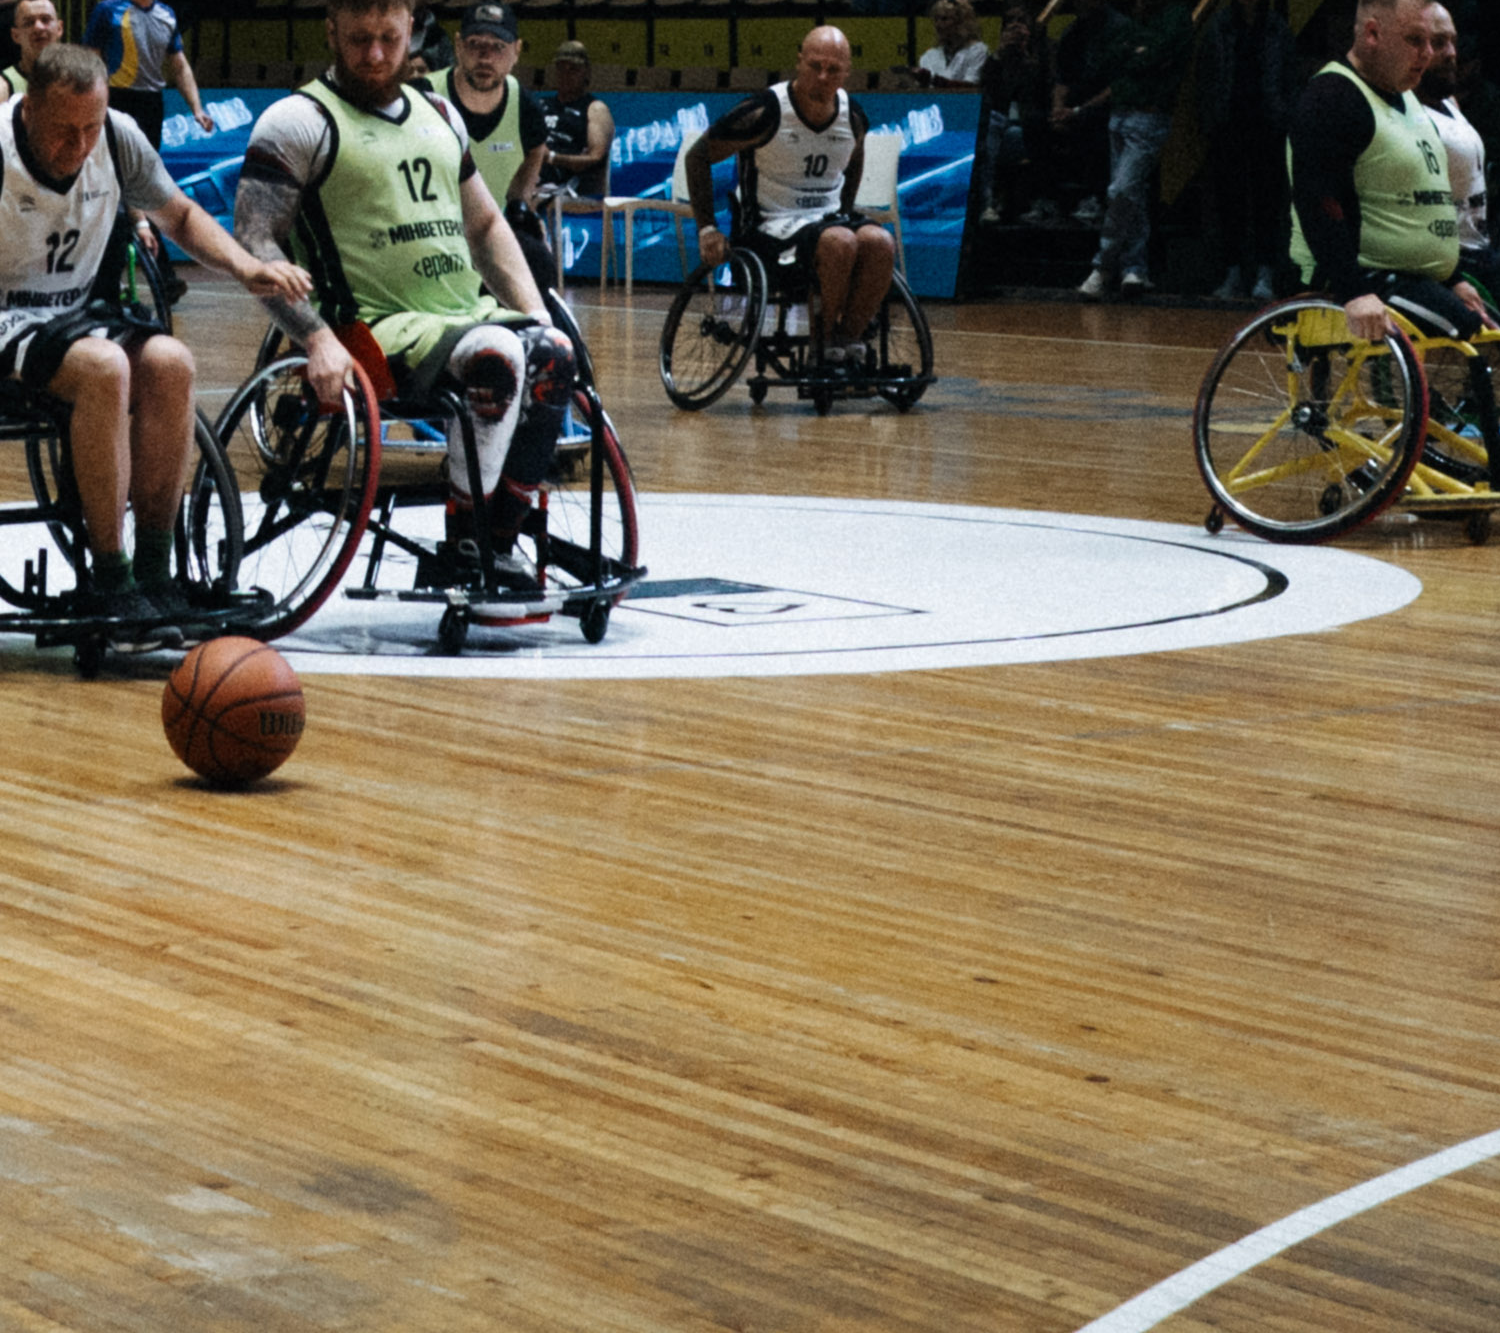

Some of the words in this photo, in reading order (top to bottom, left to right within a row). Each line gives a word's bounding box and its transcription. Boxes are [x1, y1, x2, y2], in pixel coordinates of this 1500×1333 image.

[803, 154, 828, 178] 10
[1416, 139, 1440, 175] 16
[397, 157, 437, 202] 12
[45, 229, 80, 274] 12
